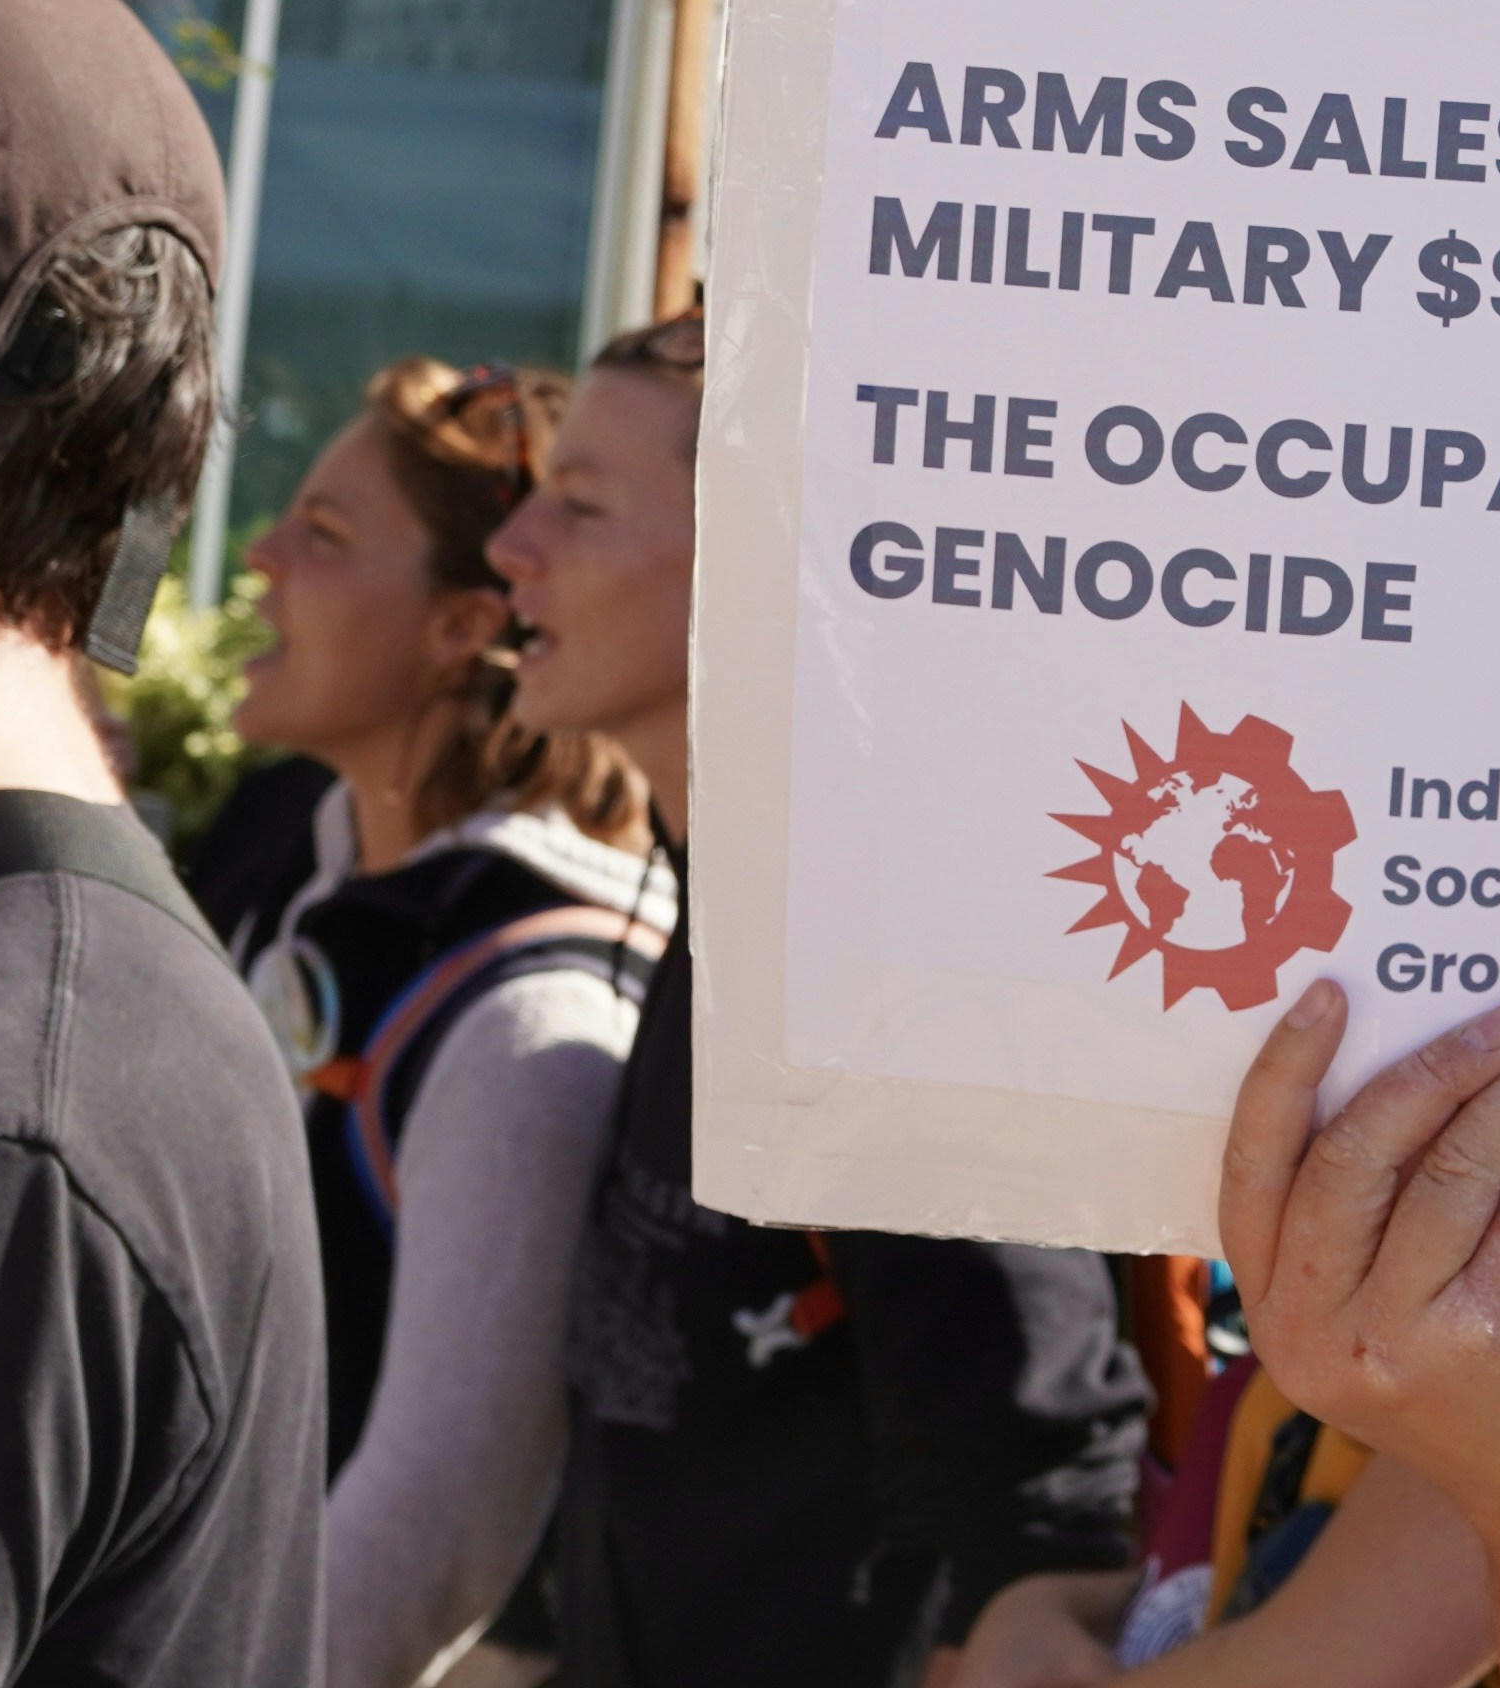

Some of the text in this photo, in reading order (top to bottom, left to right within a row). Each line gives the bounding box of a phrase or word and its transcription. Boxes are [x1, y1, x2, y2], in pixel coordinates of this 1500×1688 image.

[873, 60, 1198, 163] ARMS
[867, 194, 1394, 314] MILITARY
[855, 382, 1059, 480] THE
[848, 520, 1418, 644] GENOCIDE
